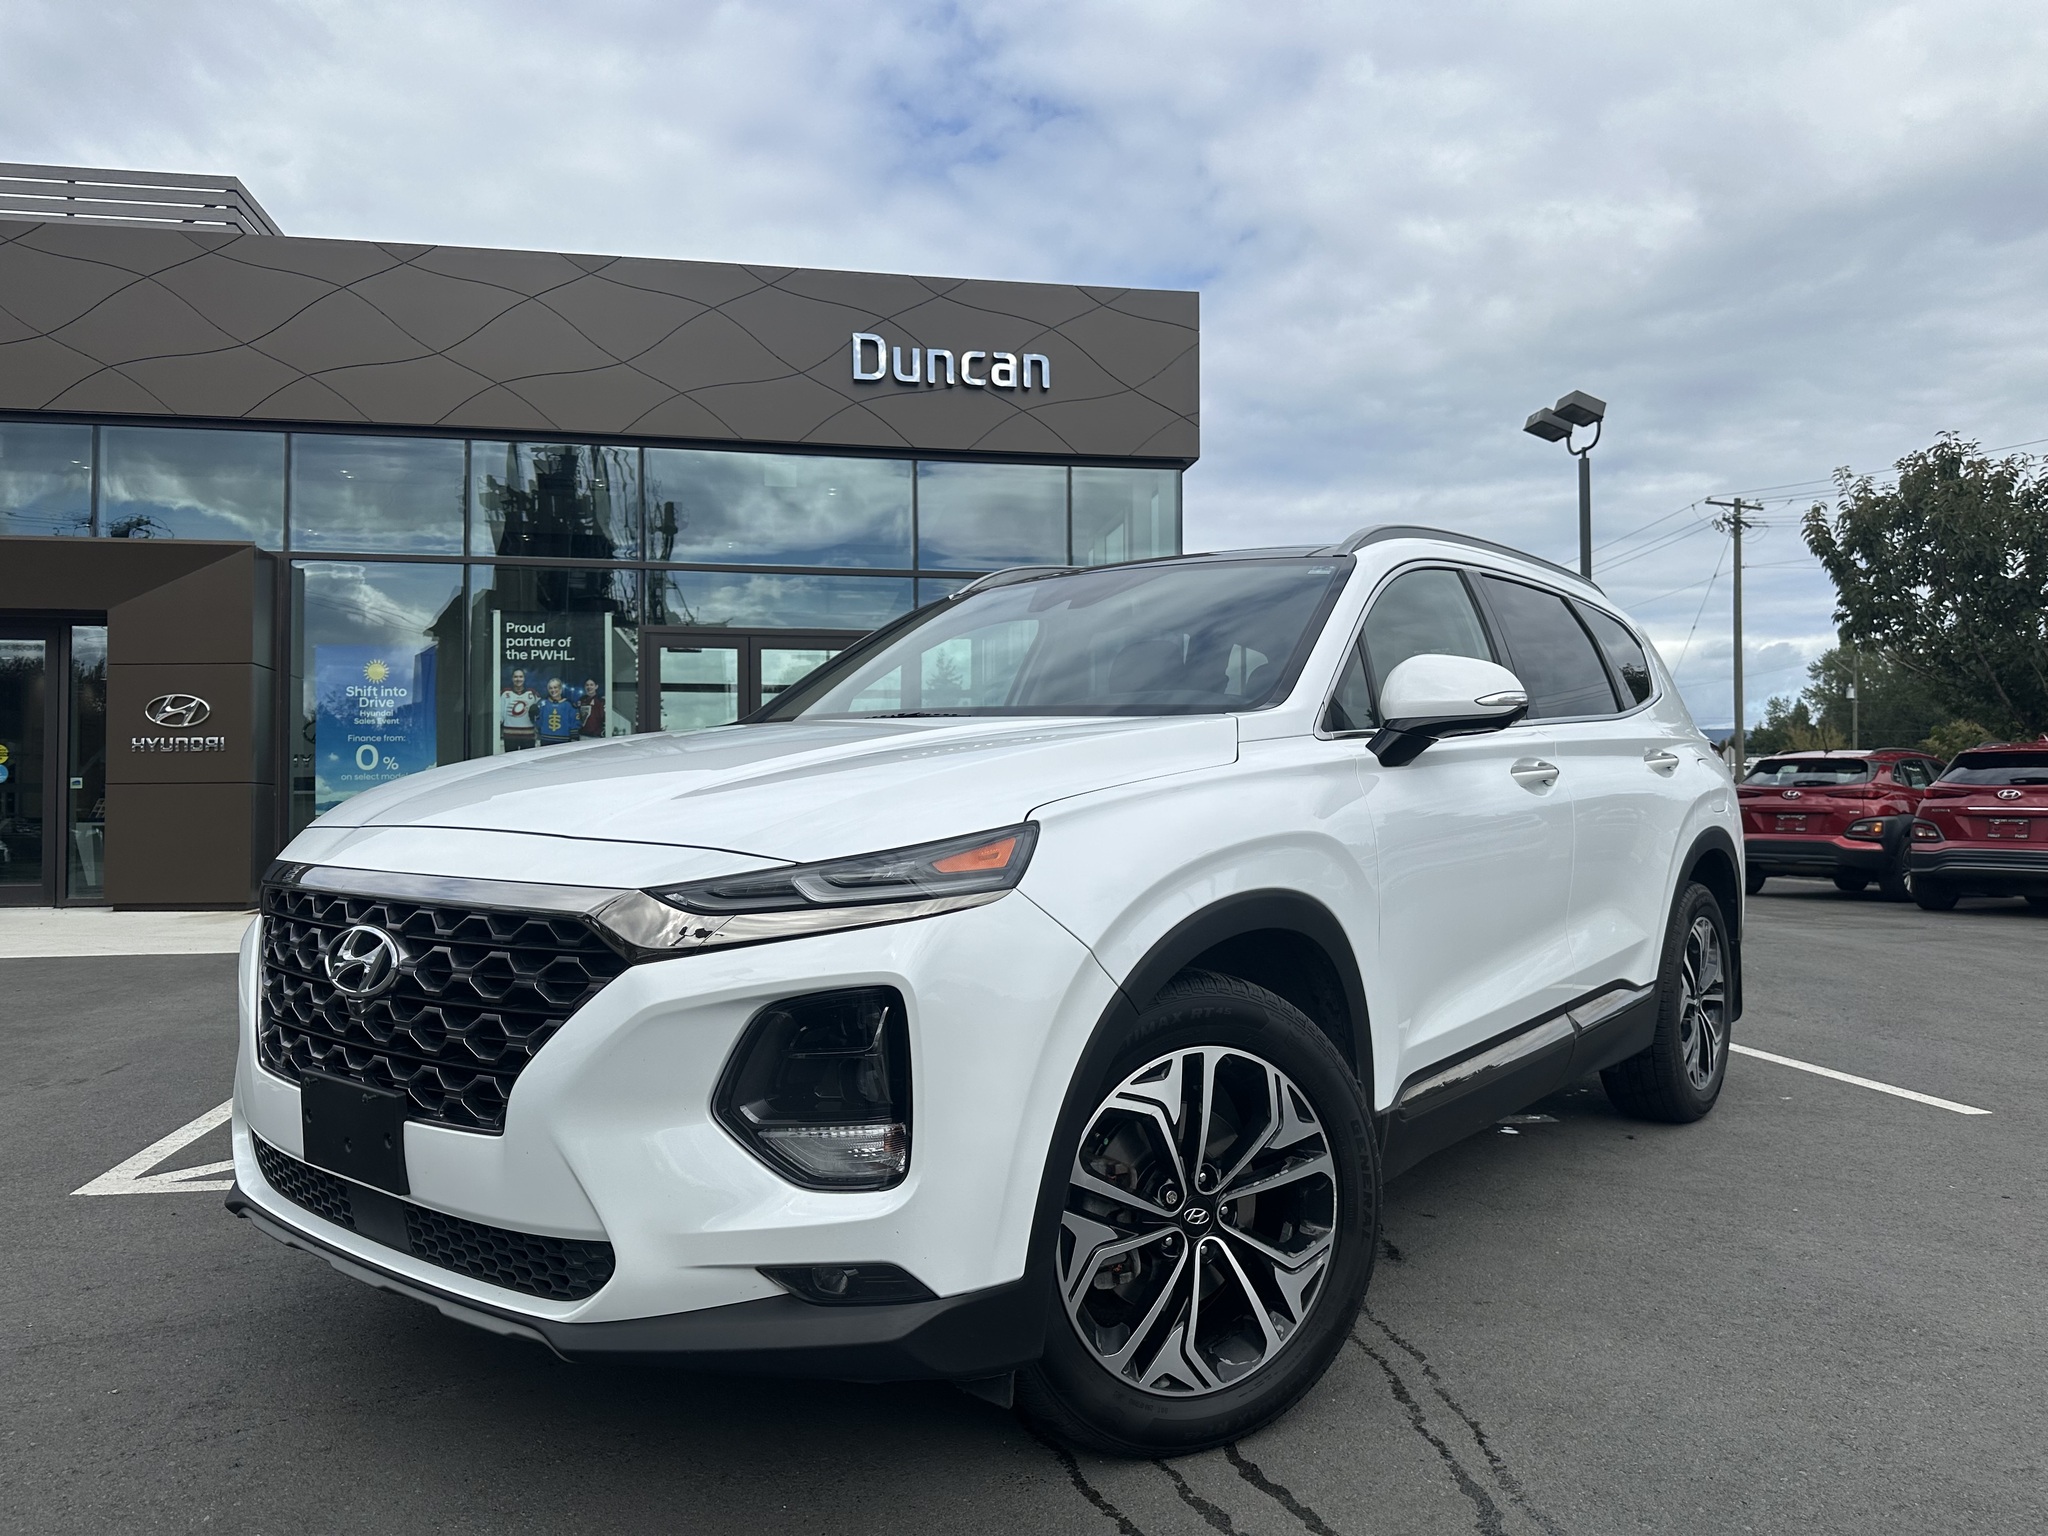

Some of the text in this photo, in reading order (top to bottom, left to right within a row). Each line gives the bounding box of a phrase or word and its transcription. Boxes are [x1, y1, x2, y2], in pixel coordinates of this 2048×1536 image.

[852, 332, 1051, 390] Duncan
[506, 622, 546, 634] Proud
[506, 636, 572, 649] partner of
[506, 649, 575, 661] the PWHL.
[346, 685, 407, 697] Shift into
[359, 697, 395, 708] Drive
[360, 710, 394, 718] Hyundai
[353, 717, 400, 725] Sales Event
[347, 734, 406, 742] Finance from:
[131, 736, 225, 753] HYUNDAI
[354, 772, 380, 781] select
[1350, 1119, 1373, 1244] GENERAL
